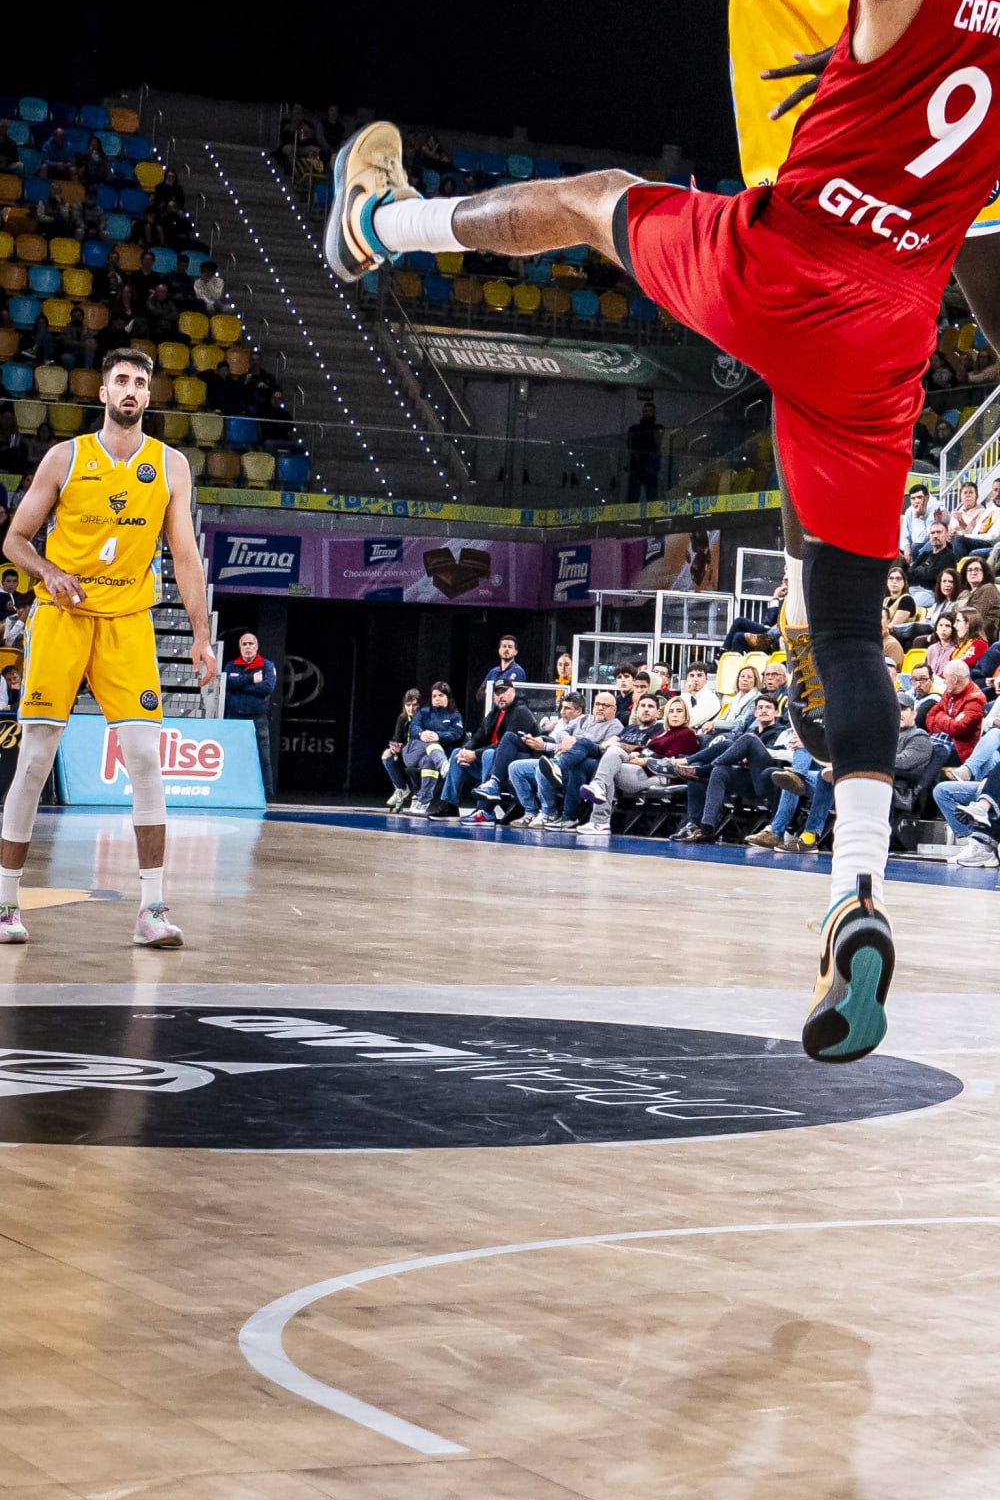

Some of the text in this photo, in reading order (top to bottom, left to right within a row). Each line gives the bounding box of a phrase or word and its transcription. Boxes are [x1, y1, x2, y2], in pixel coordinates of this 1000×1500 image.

[904, 66, 992, 179] 9
[450, 348, 562, 374] NUESTRO
[80, 514, 147, 526] DREAMLAND
[98, 537, 119, 566] 4
[227, 536, 295, 568] Tirma
[370, 544, 398, 558] Tirma
[557, 550, 588, 579] Tirma
[343, 569, 382, 578] Chocolate
[104, 729, 221, 781] Klise
[198, 1015, 806, 1120] DREAMLAND
